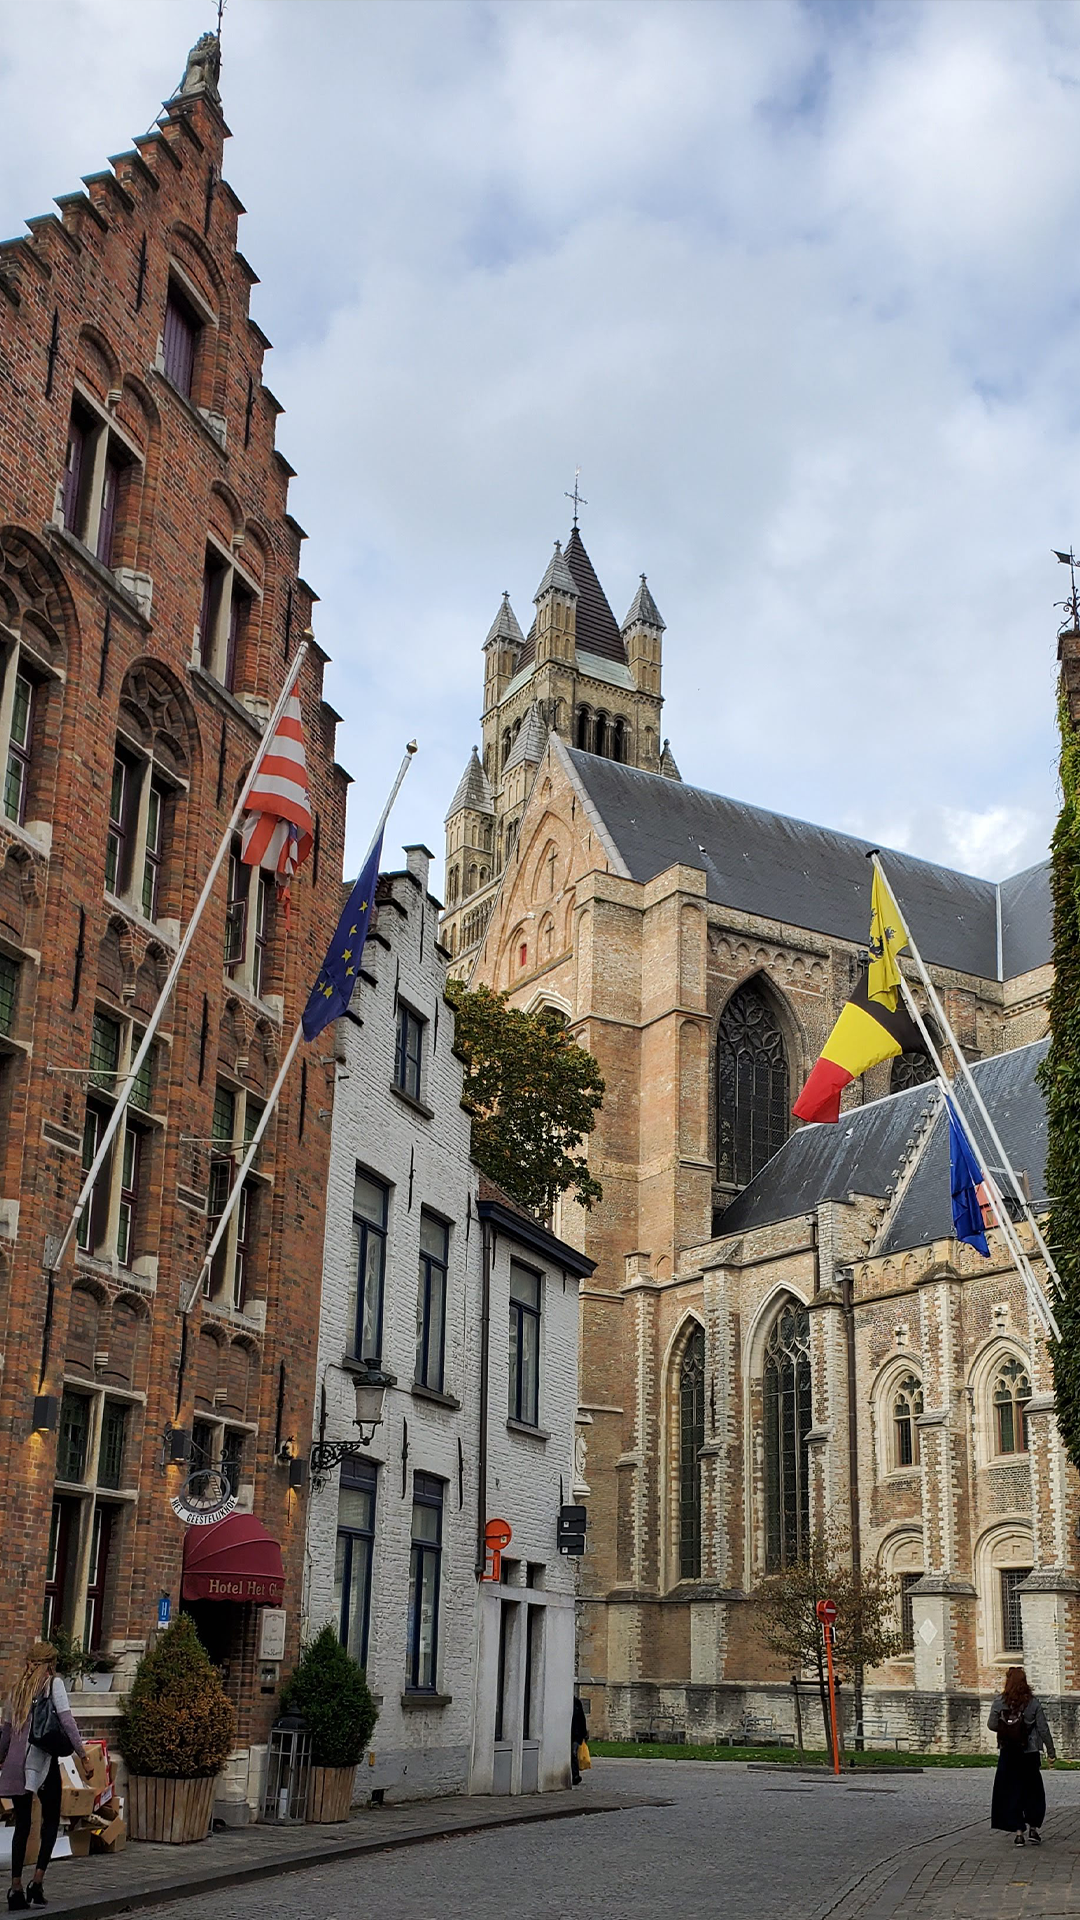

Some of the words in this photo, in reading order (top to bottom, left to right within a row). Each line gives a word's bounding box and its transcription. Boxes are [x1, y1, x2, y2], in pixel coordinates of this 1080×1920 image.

[171, 1499, 184, 1515] HET
[186, 1499, 237, 1525] GEESTELIJKHOF
[208, 1578, 243, 1595] Hotel
[247, 1579, 266, 1596] Het
